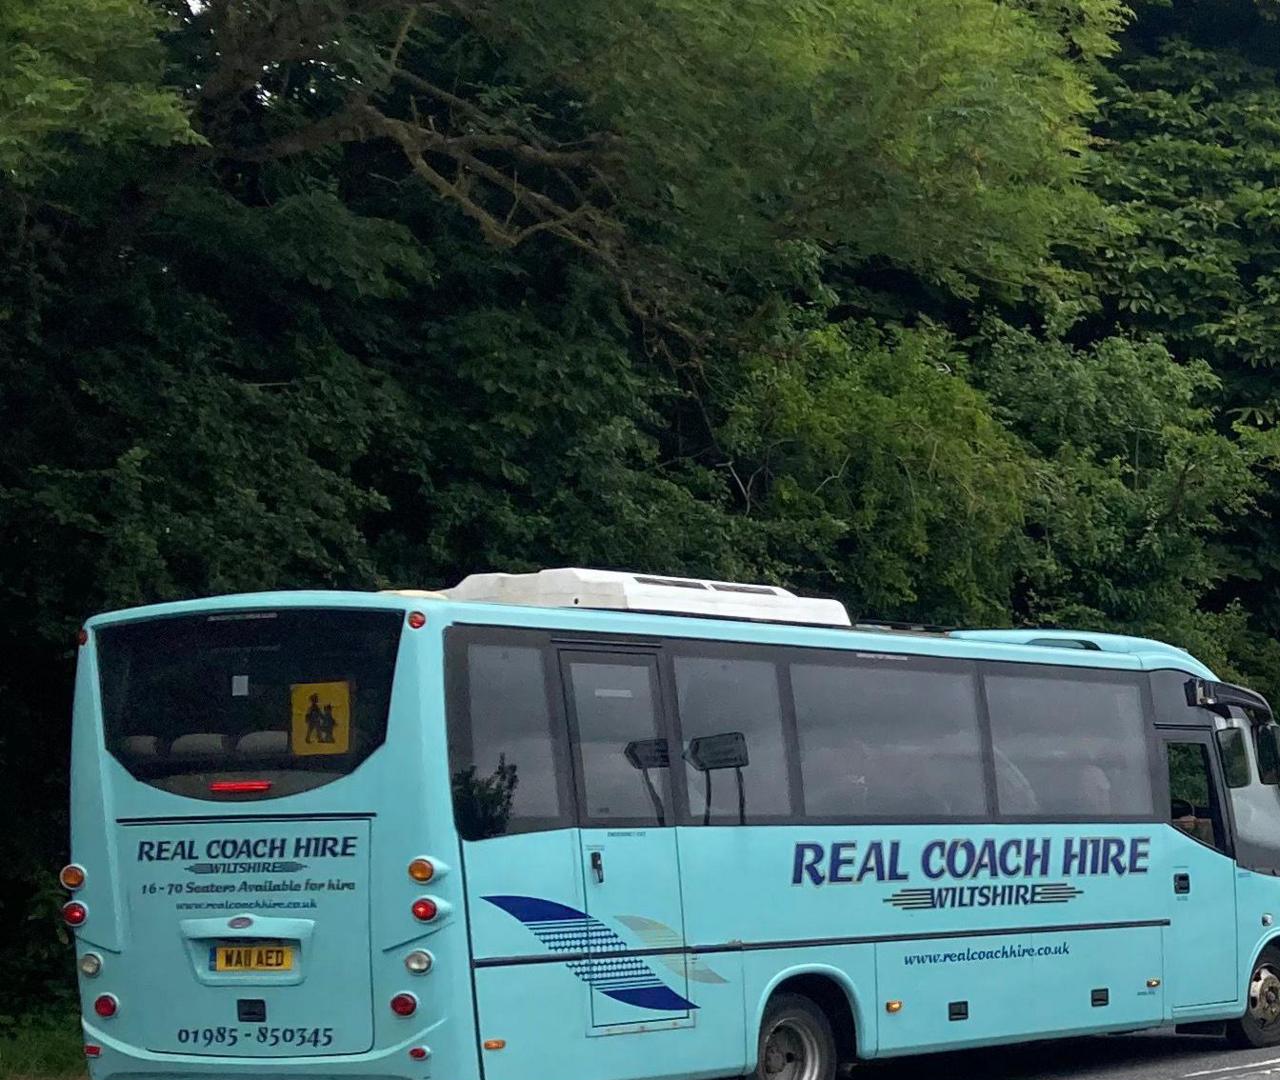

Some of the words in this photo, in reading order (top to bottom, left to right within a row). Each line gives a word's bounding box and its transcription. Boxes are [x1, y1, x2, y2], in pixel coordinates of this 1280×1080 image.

[137, 840, 198, 862] REAL
[206, 837, 287, 859] COACH
[293, 836, 358, 858] HIRE
[209, 861, 282, 873] WILTSHIRE
[791, 841, 910, 886] REAL
[920, 837, 1052, 880] COACH
[1061, 836, 1151, 877] HIRE
[142, 883, 157, 894] 16
[168, 883, 183, 895] 70
[185, 881, 236, 893] Seaters
[238, 880, 301, 892] Available
[304, 879, 325, 891] for
[328, 879, 356, 890] hire
[930, 883, 1041, 908] WILTSHIRE
[176, 899, 318, 910] www.realcoachhire.co.uk
[255, 950, 284, 967] AED
[904, 942, 1070, 966] www.realcoachhire.co.uk
[177, 1026, 239, 1047] 01985
[256, 1026, 334, 1048] 850345
